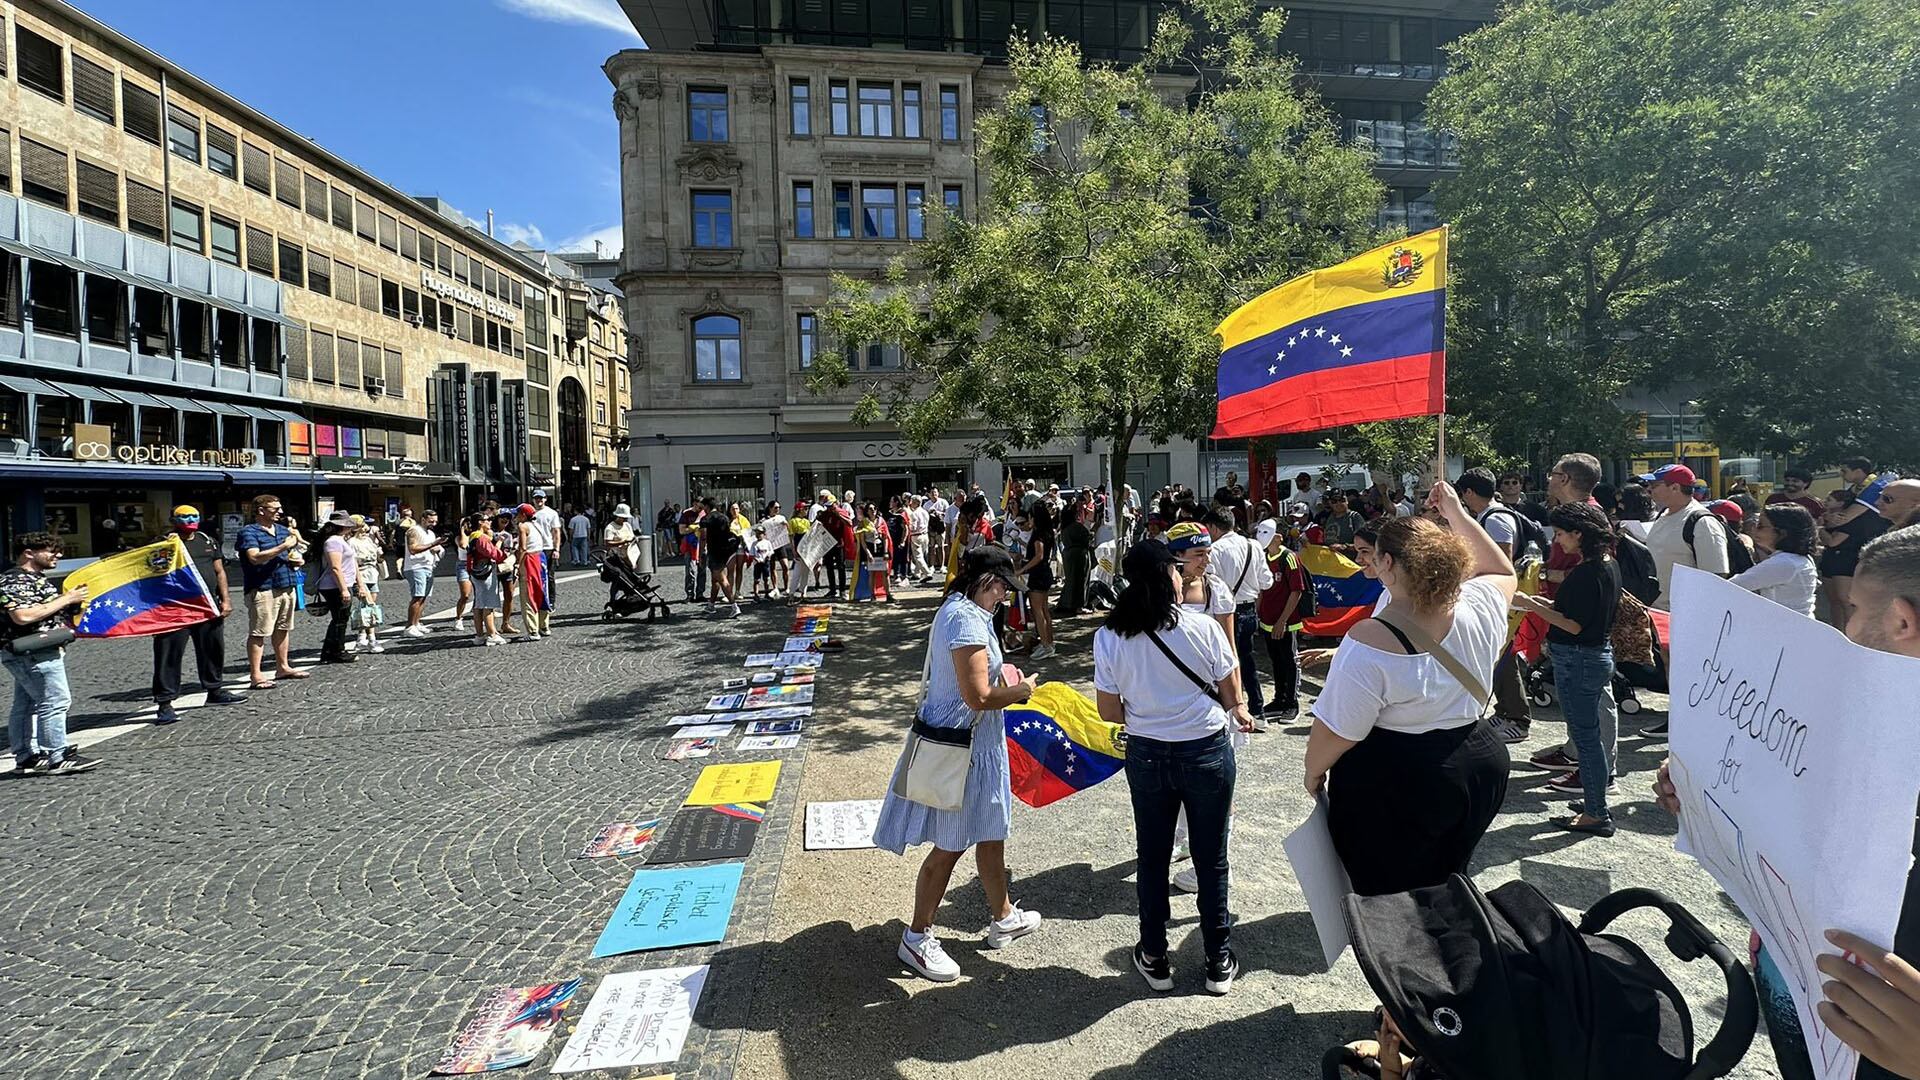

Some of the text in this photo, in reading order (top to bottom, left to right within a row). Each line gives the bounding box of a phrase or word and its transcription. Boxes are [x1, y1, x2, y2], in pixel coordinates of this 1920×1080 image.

[458, 383, 468, 461] Hugendubel
[118, 444, 258, 467] optiker müller
[862, 443, 908, 457] COS
[1712, 735, 1743, 794] for
